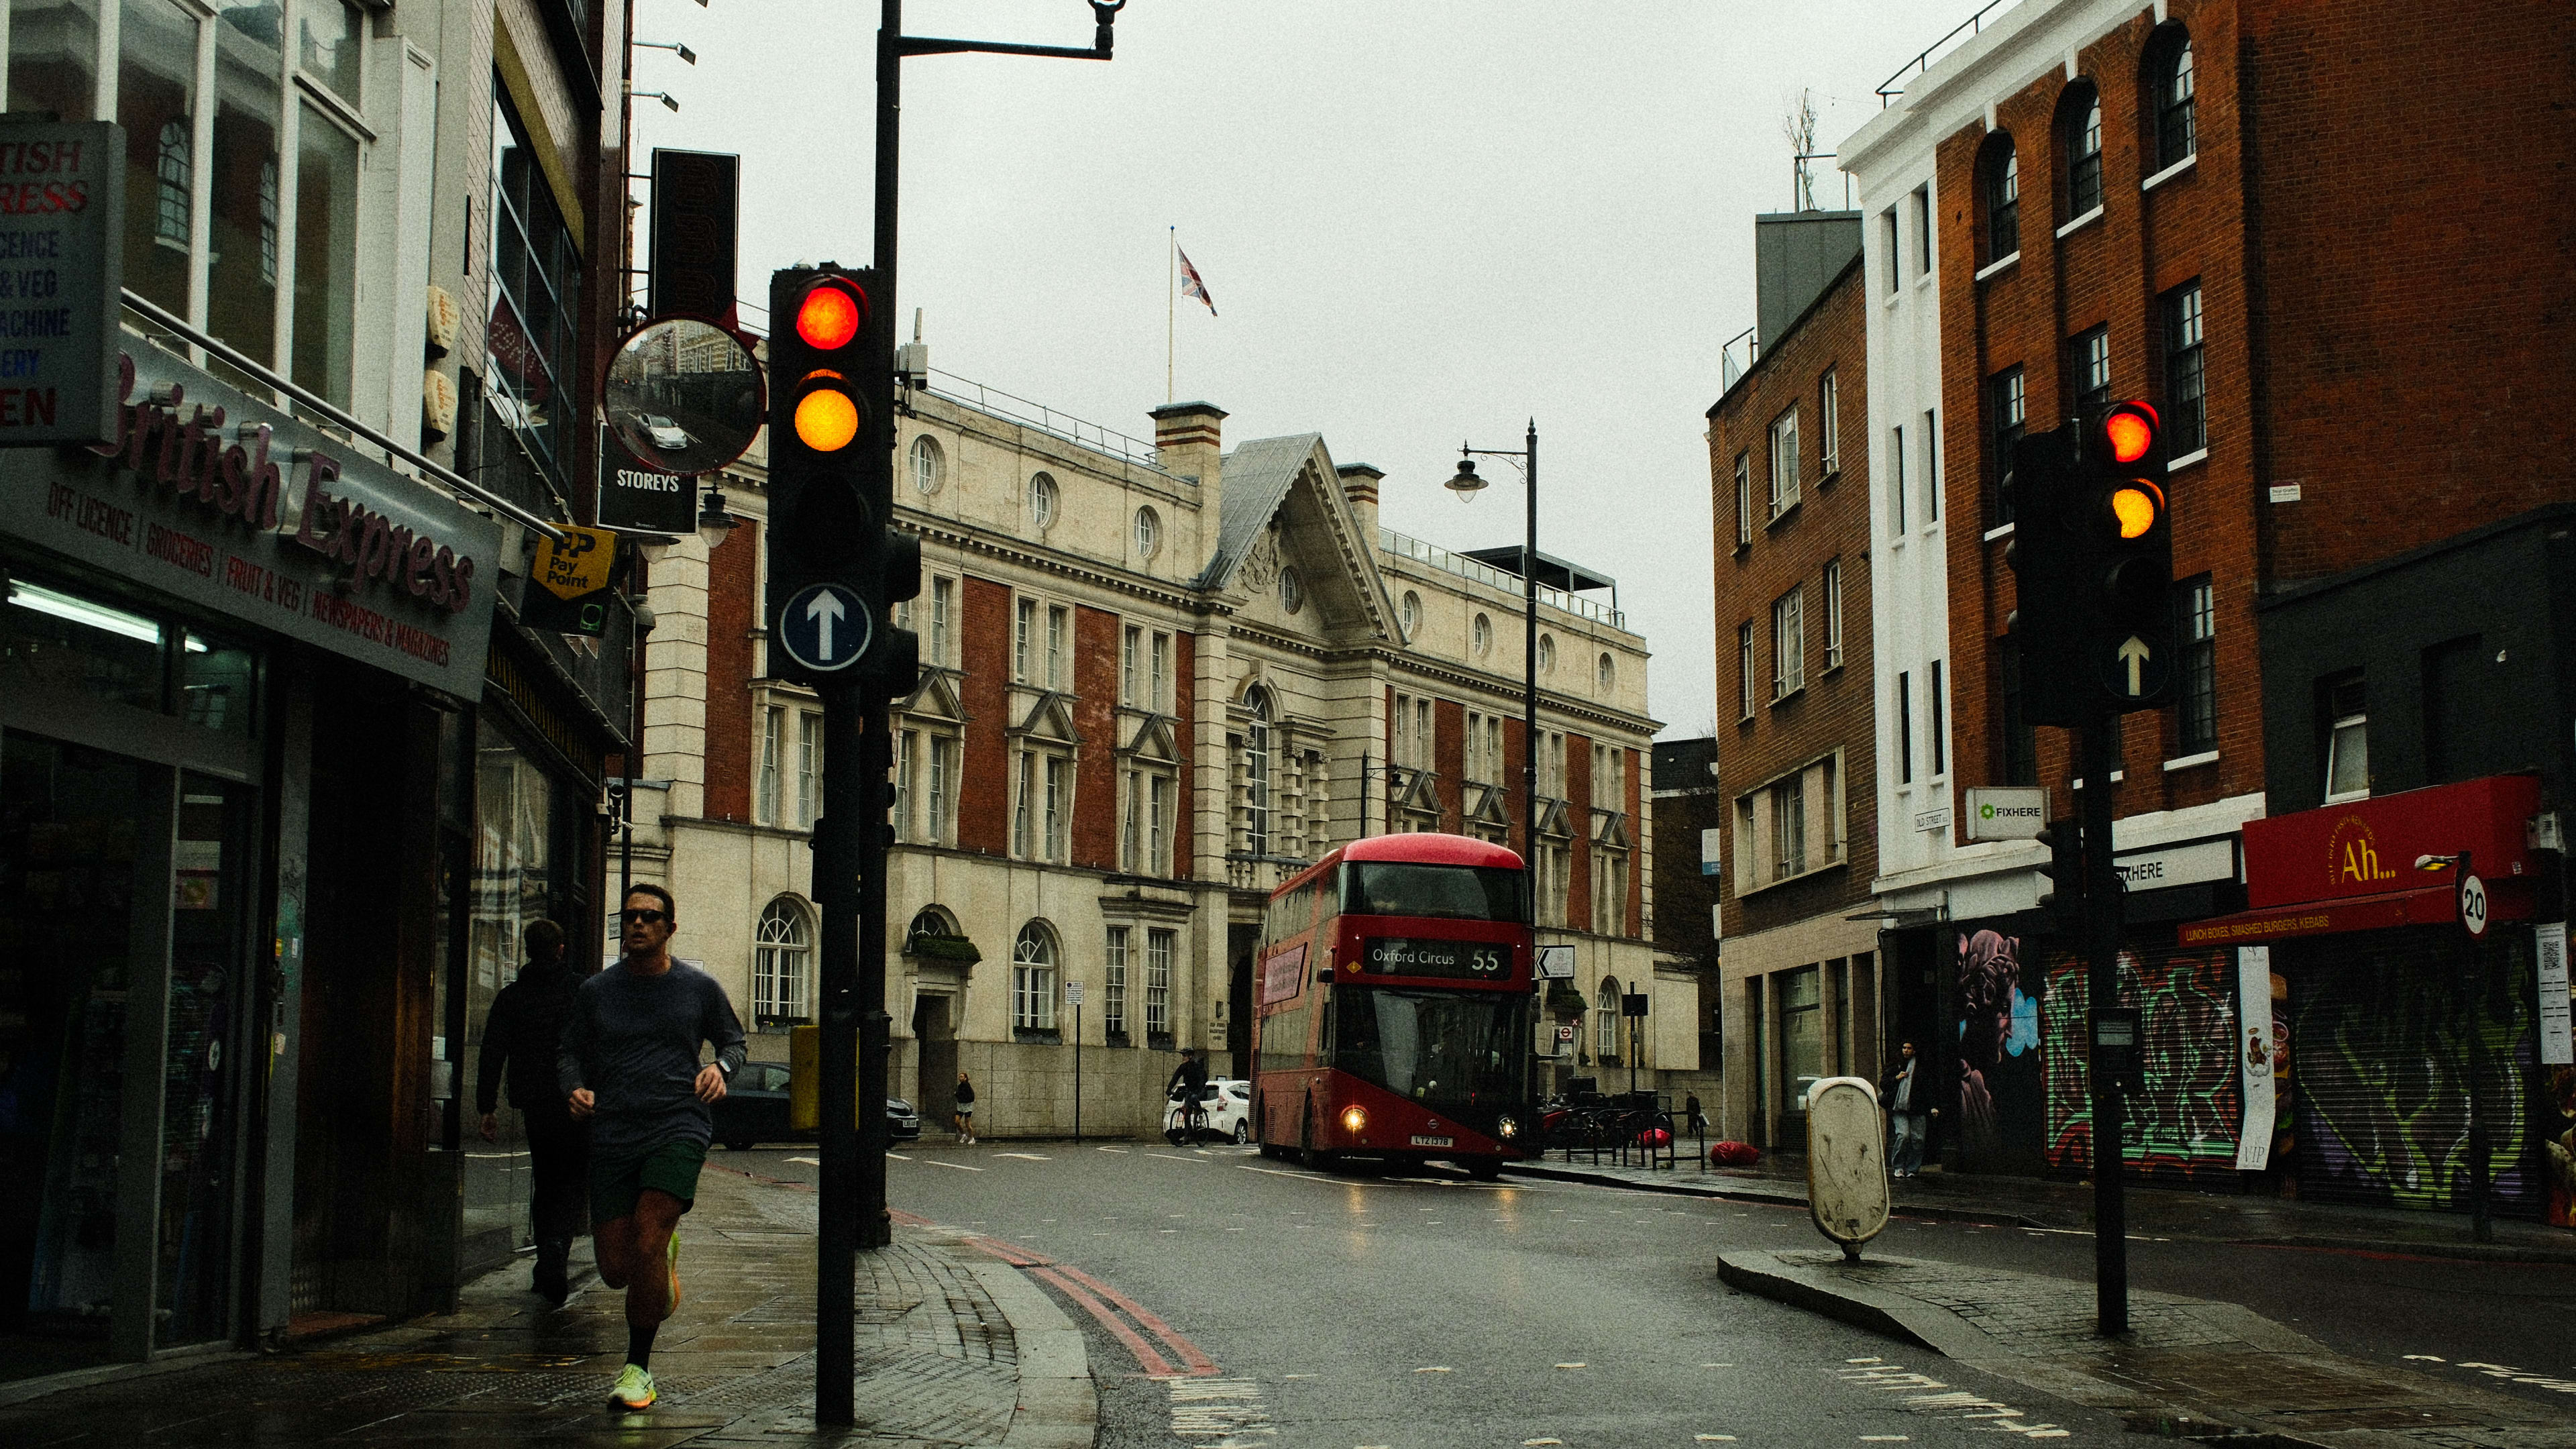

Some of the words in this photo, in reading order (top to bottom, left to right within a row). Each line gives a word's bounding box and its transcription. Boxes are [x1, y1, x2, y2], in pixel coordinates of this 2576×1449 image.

[17, 269, 58, 298] VEG
[616, 468, 680, 493] STOREYS
[297, 450, 474, 613] Express
[47, 481, 75, 522] OFF
[77, 494, 133, 546] LICENCE
[146, 522, 213, 578] GROCERIES
[226, 555, 263, 597] FRUIT
[264, 571, 274, 602] &
[277, 575, 301, 612] VEG
[312, 590, 384, 643] NEWSPAPERS
[384, 619, 392, 647] &
[396, 623, 450, 668] MAGAZINES
[549, 556, 578, 575] Pay
[547, 570, 589, 588] Point
[1925, 814, 1942, 826] STREET
[1996, 807, 2041, 817] FIXHERE
[2341, 839, 2396, 883] Ah...
[2465, 888, 2485, 921] 20
[2186, 929, 2207, 941] LUNCH
[2231, 922, 2263, 936] SMASHED
[2300, 915, 2330, 930] KEBABS
[1372, 948, 1415, 963] Oxford
[1418, 951, 1455, 965] Circus
[1471, 949, 1499, 971] 55
[2245, 1146, 2265, 1163] VIP
